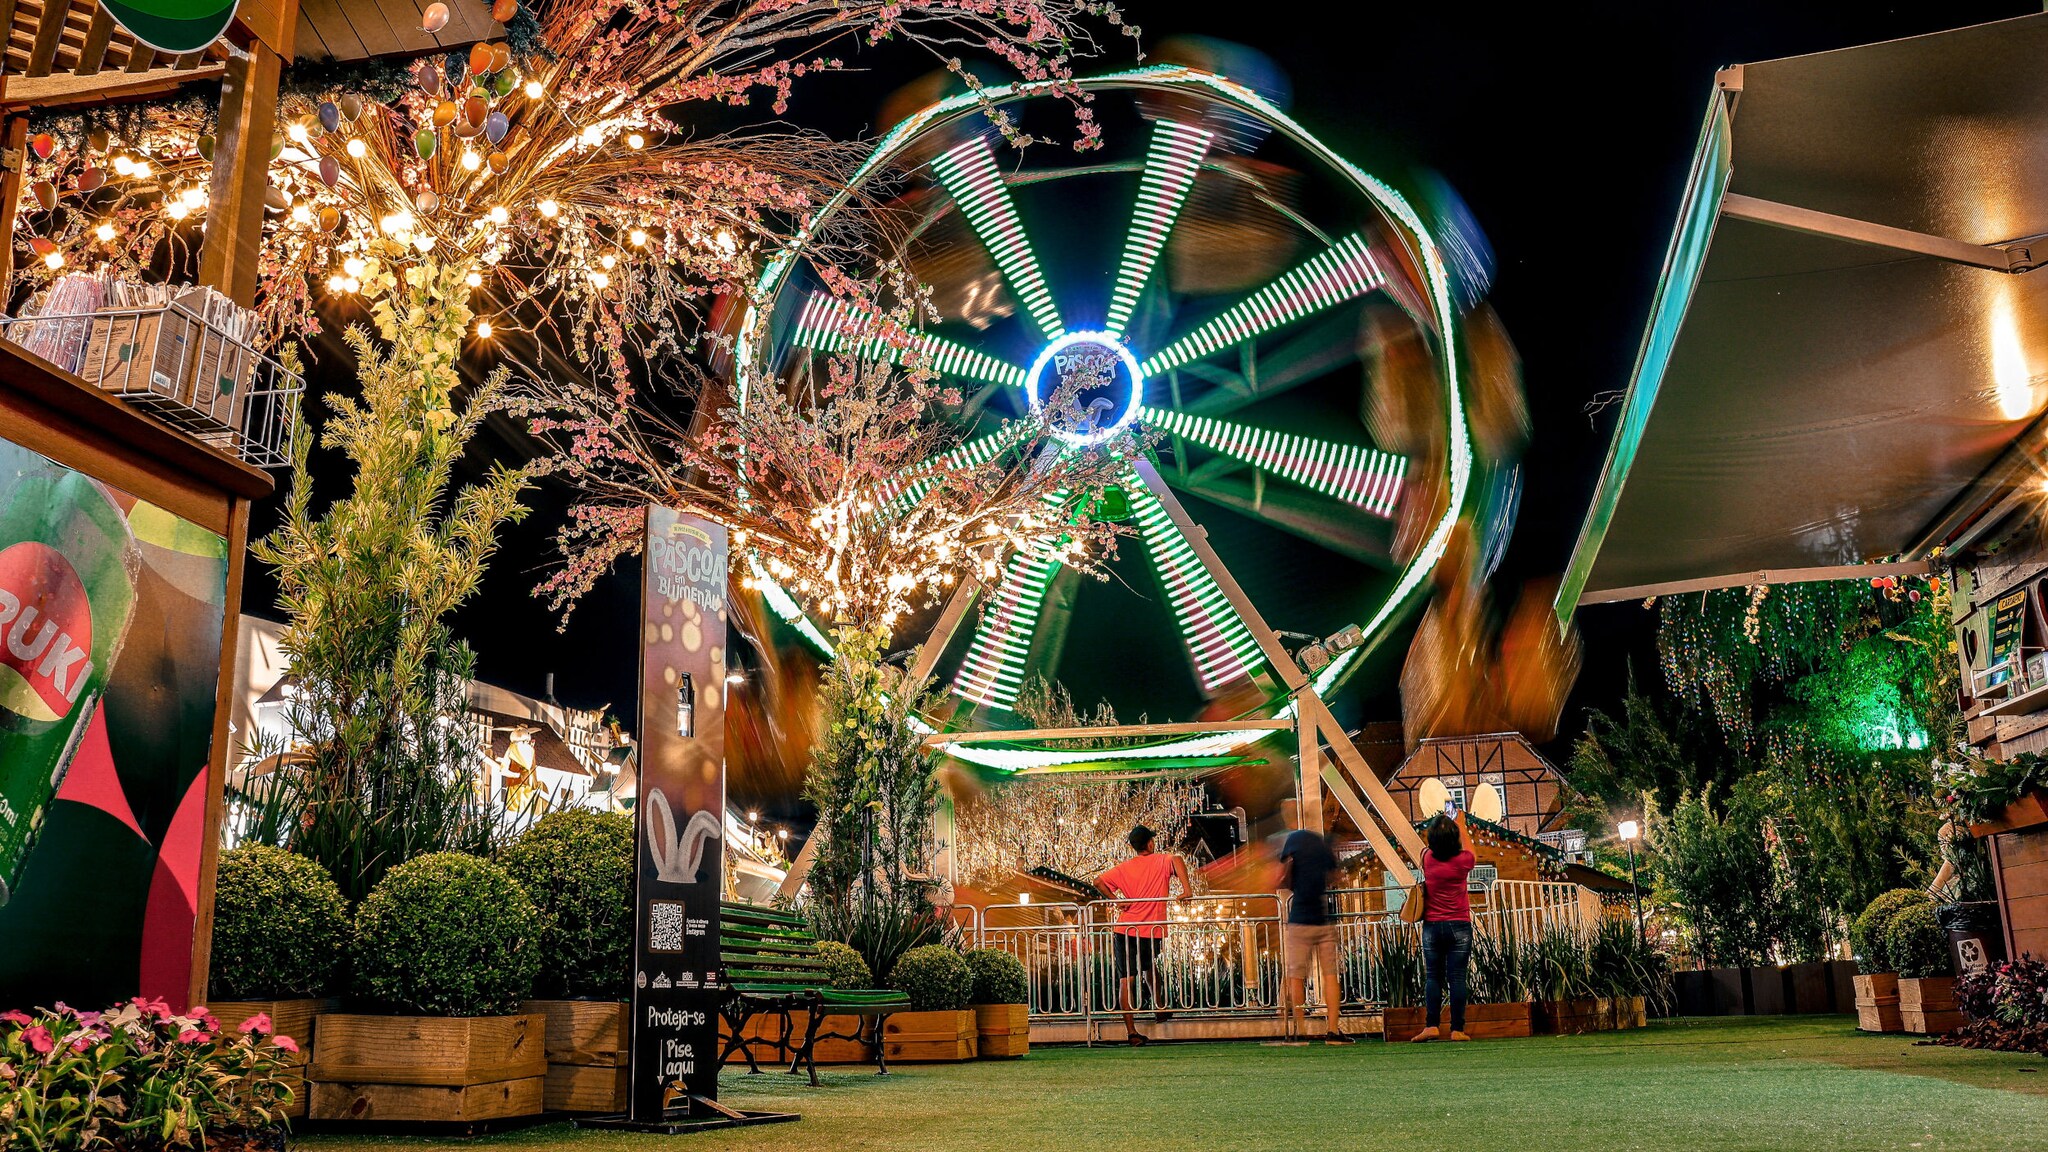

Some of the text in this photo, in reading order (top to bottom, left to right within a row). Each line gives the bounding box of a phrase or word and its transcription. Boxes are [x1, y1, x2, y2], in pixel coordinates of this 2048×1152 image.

[650, 535, 727, 600] PÁSCOA
[647, 1005, 706, 1032] Proteja-se
[665, 1061, 694, 1082] aqui
